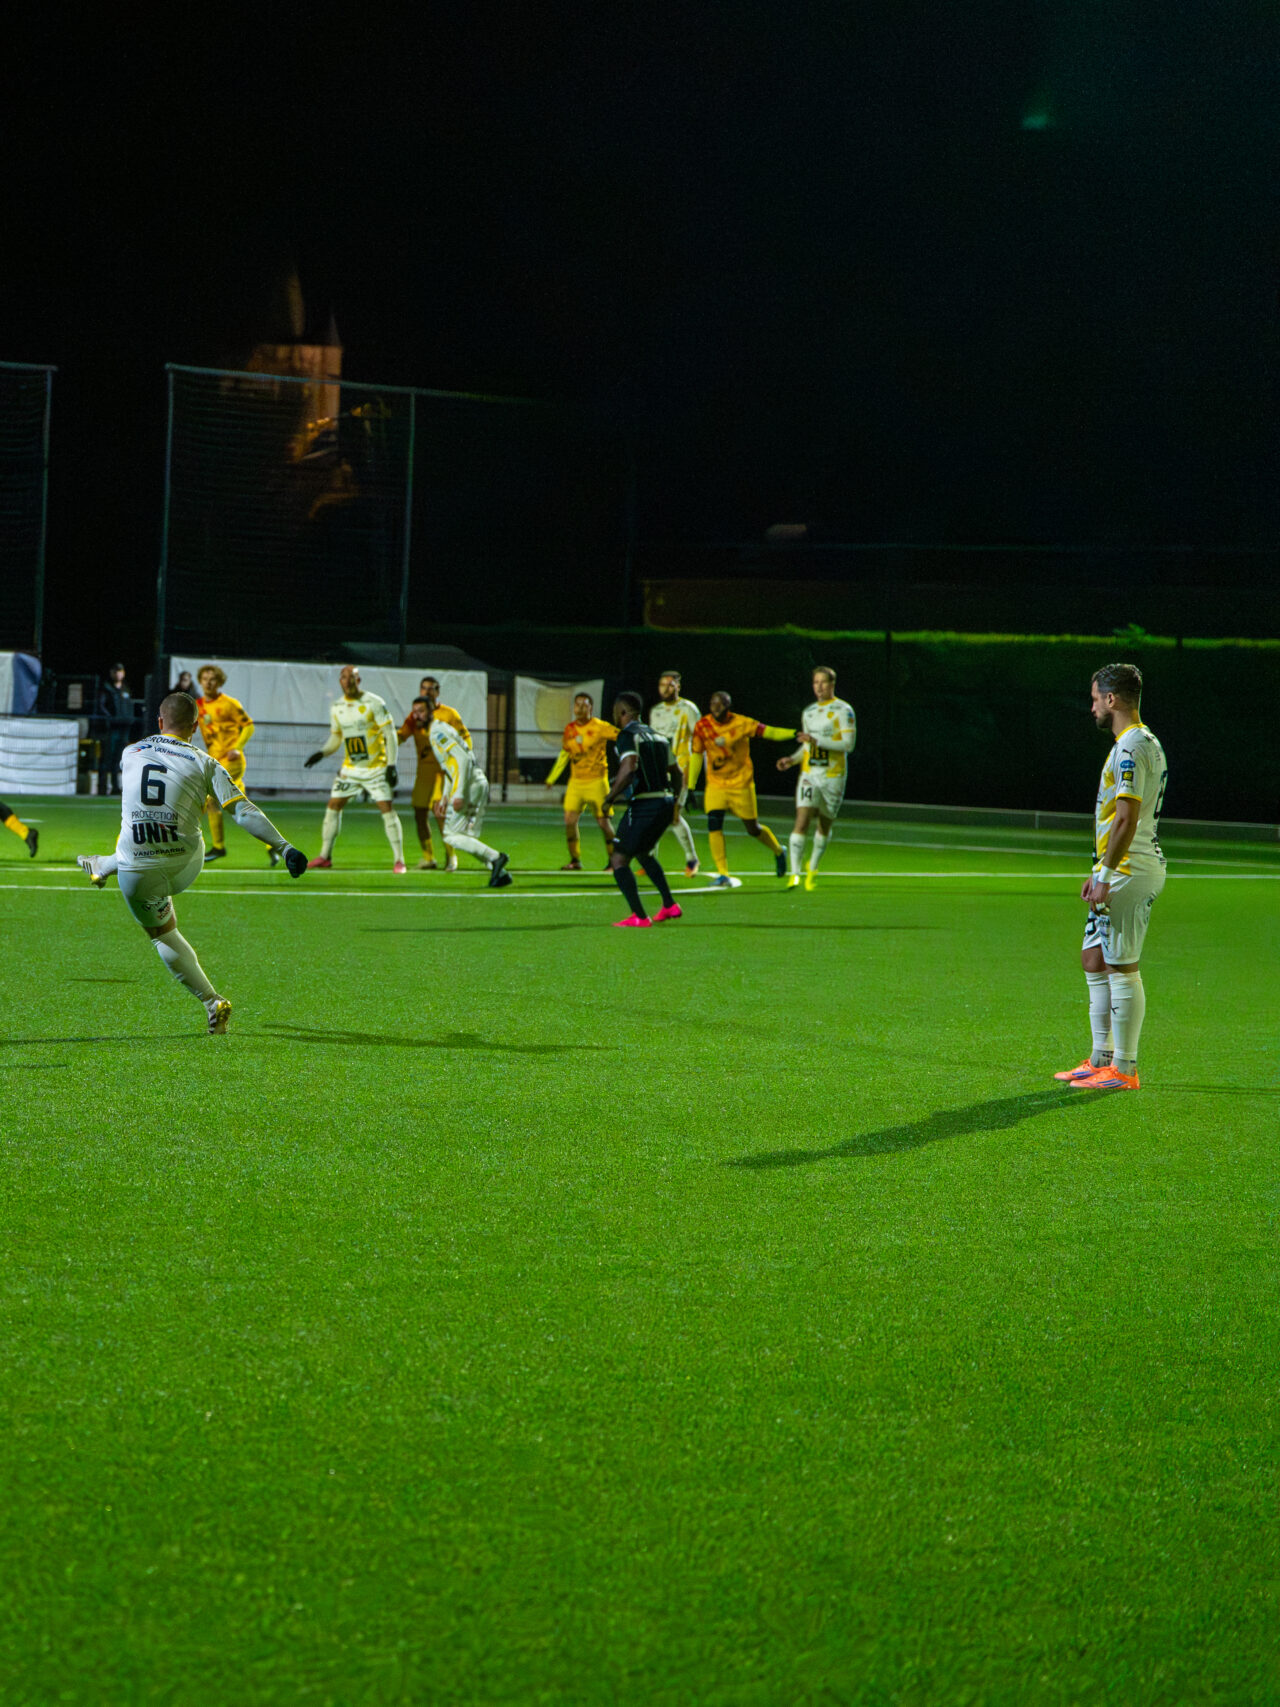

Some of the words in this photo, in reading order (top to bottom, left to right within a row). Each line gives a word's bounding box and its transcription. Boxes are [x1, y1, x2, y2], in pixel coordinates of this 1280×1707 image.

[141, 763, 167, 806] 6
[801, 786, 812, 801] 14
[131, 810, 179, 821] PROTECTION
[132, 821, 179, 845] UNIT
